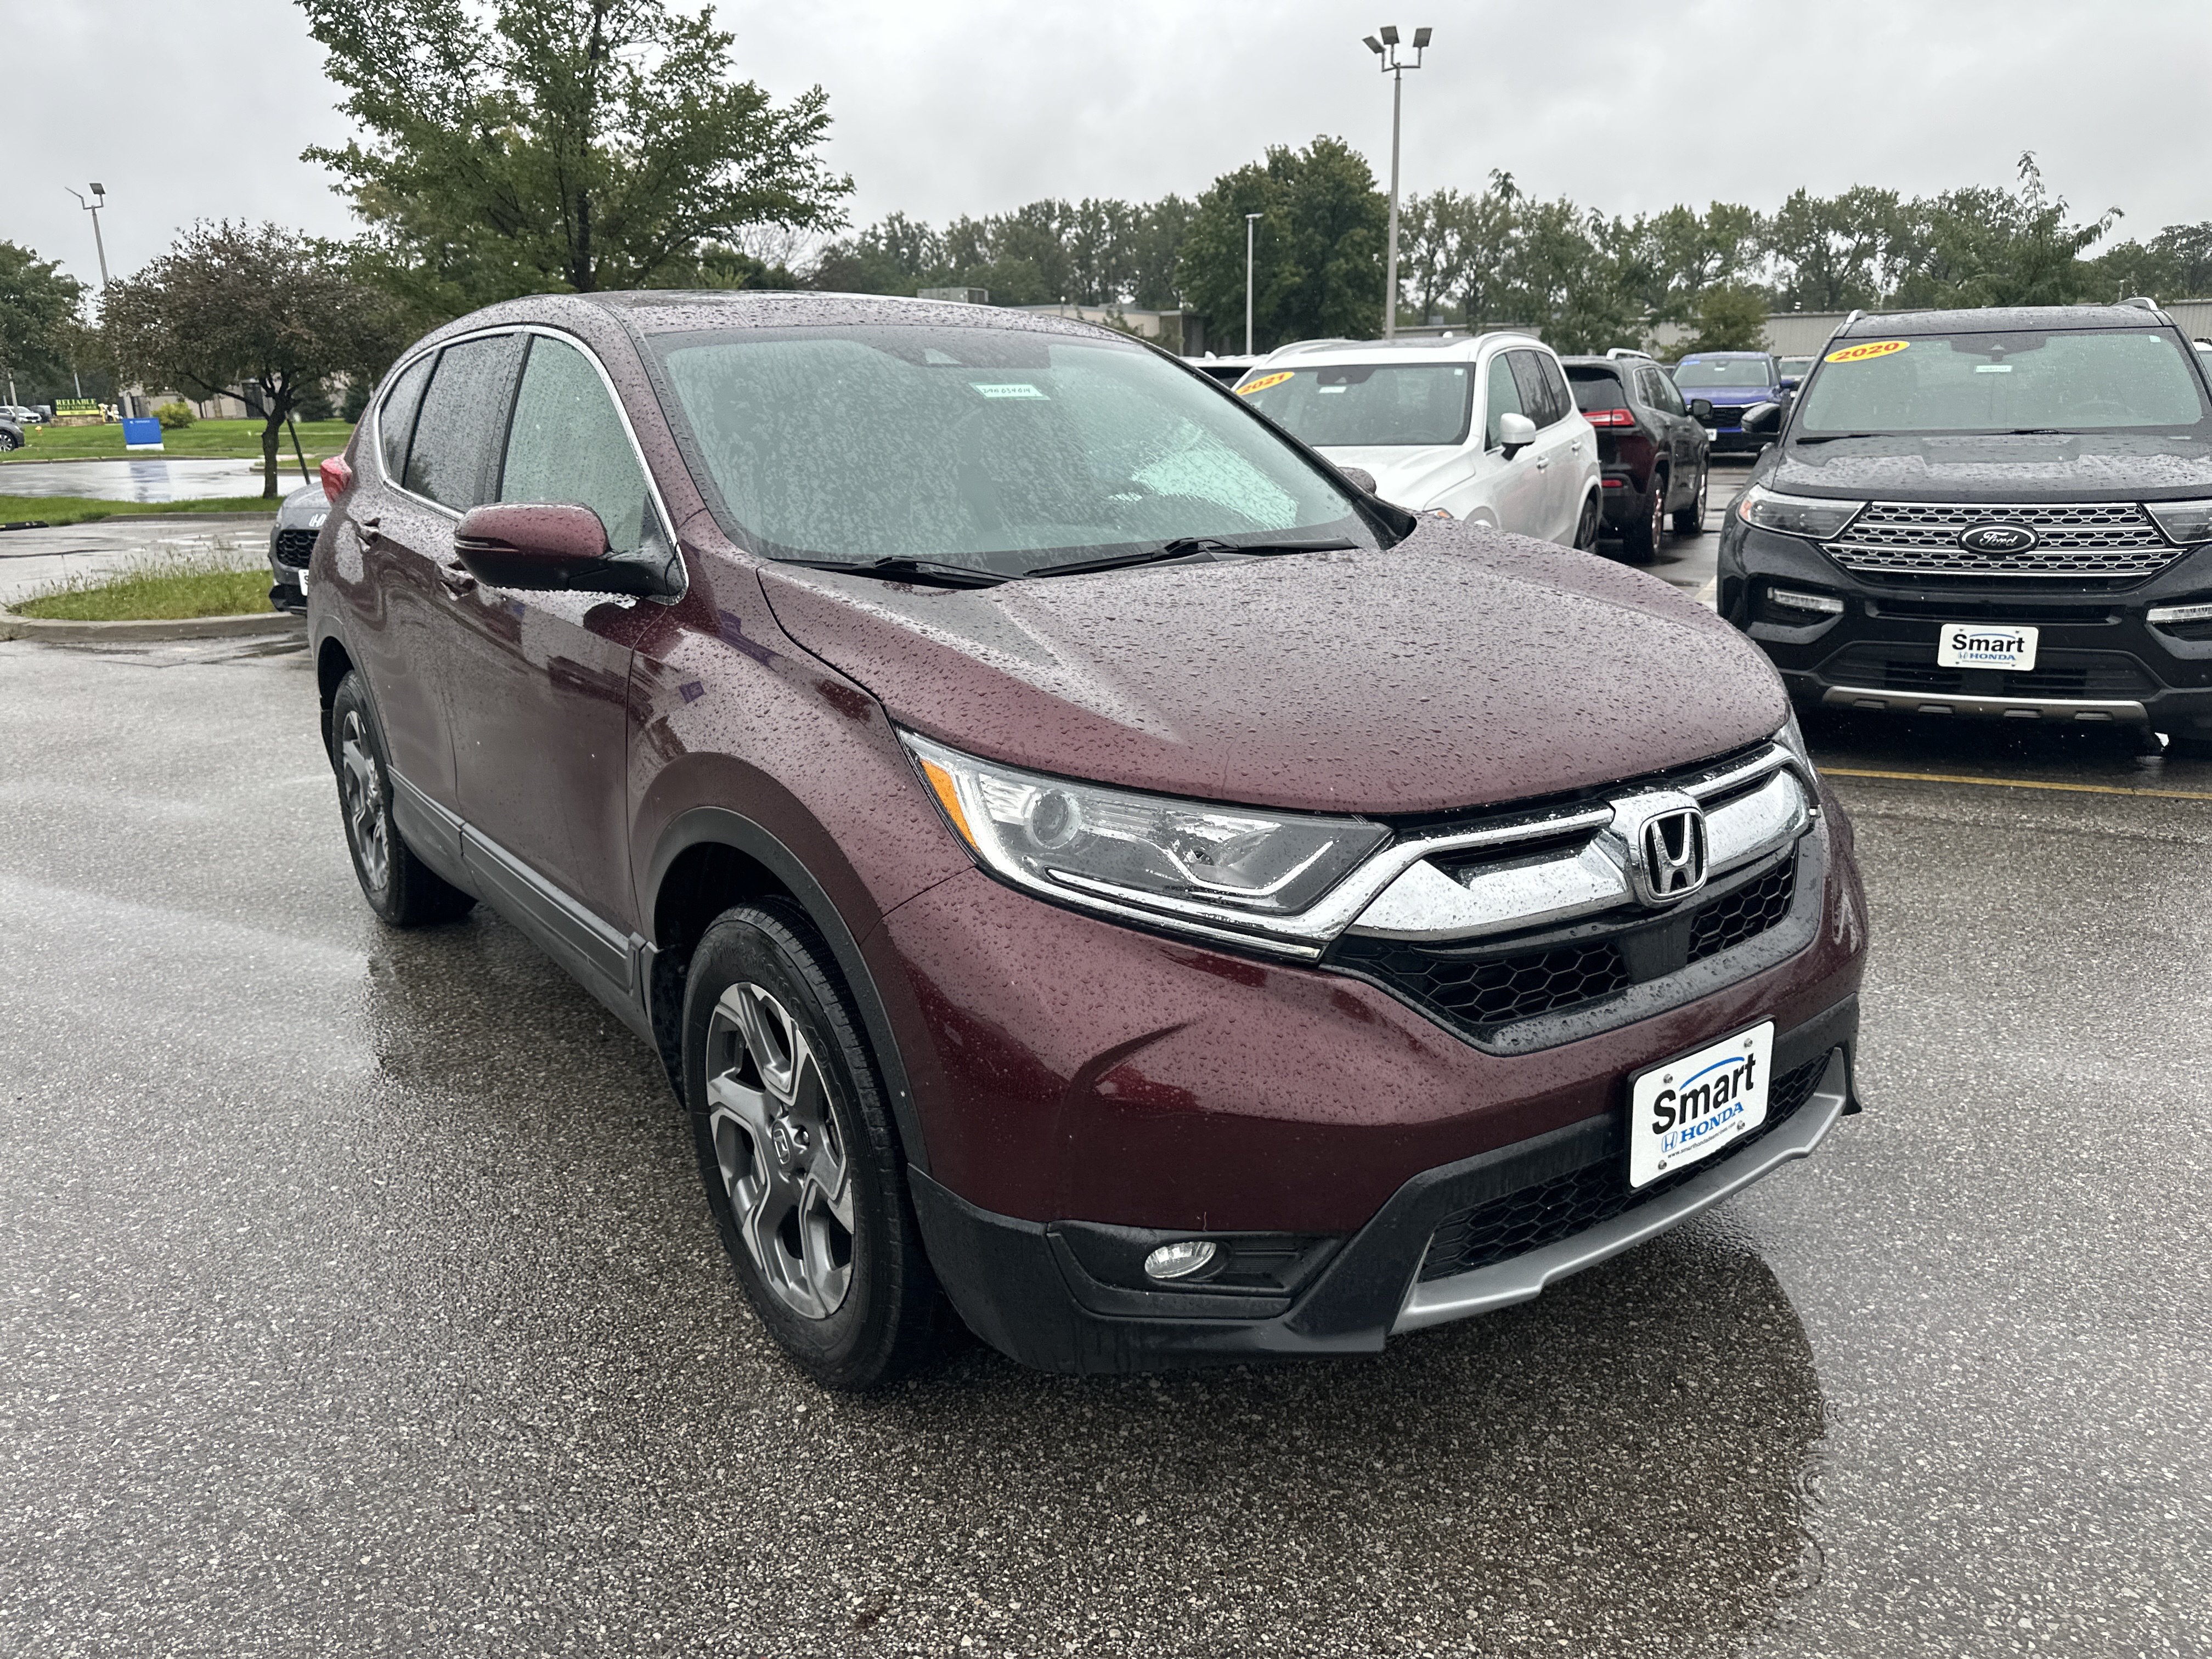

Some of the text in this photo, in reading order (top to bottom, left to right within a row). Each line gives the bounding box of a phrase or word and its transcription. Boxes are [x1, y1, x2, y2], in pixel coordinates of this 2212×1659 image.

[1835, 342, 1899, 361] 2020
[1240, 374, 1285, 393] 2021
[1979, 531, 2018, 546] Ford
[1951, 634, 2025, 653] Smart
[1652, 1053, 1756, 1135] Smart
[1679, 1102, 1744, 1143] HONDA
